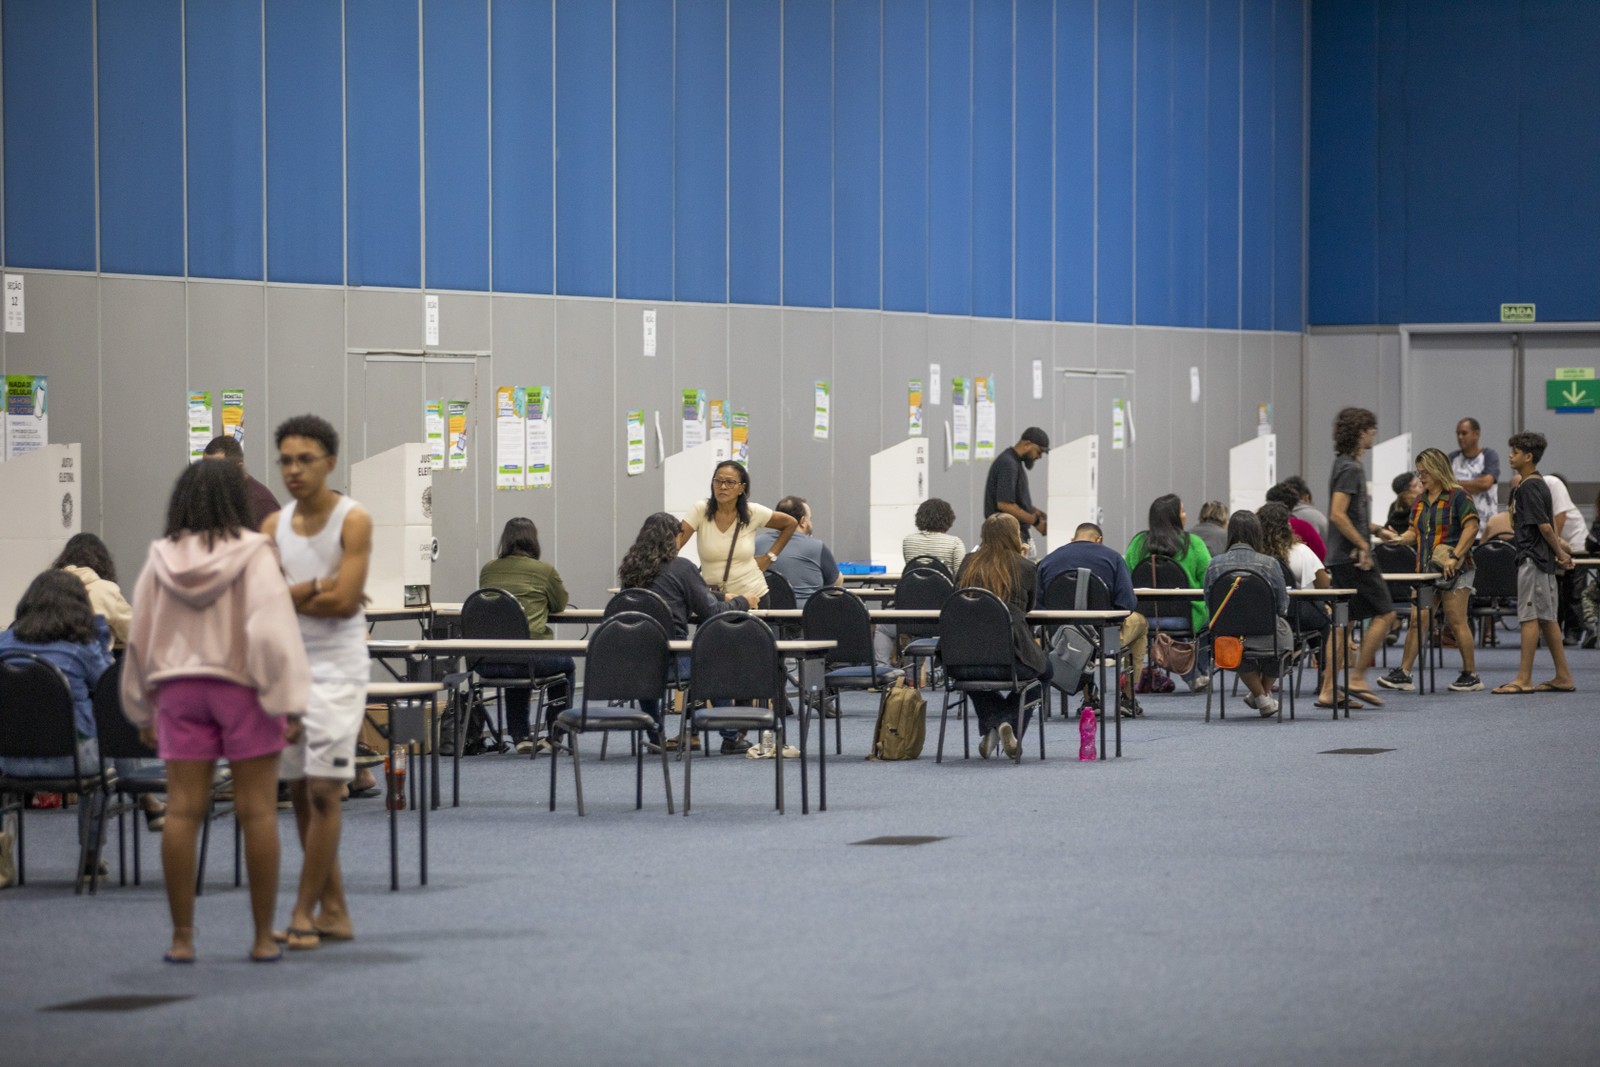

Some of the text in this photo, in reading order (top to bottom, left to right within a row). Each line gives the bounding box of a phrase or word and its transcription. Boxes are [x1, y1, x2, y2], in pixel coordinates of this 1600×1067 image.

[7, 280, 22, 290] SEÇÃO
[11, 296, 18, 306] 12
[1502, 305, 1534, 315] SAÍDA
